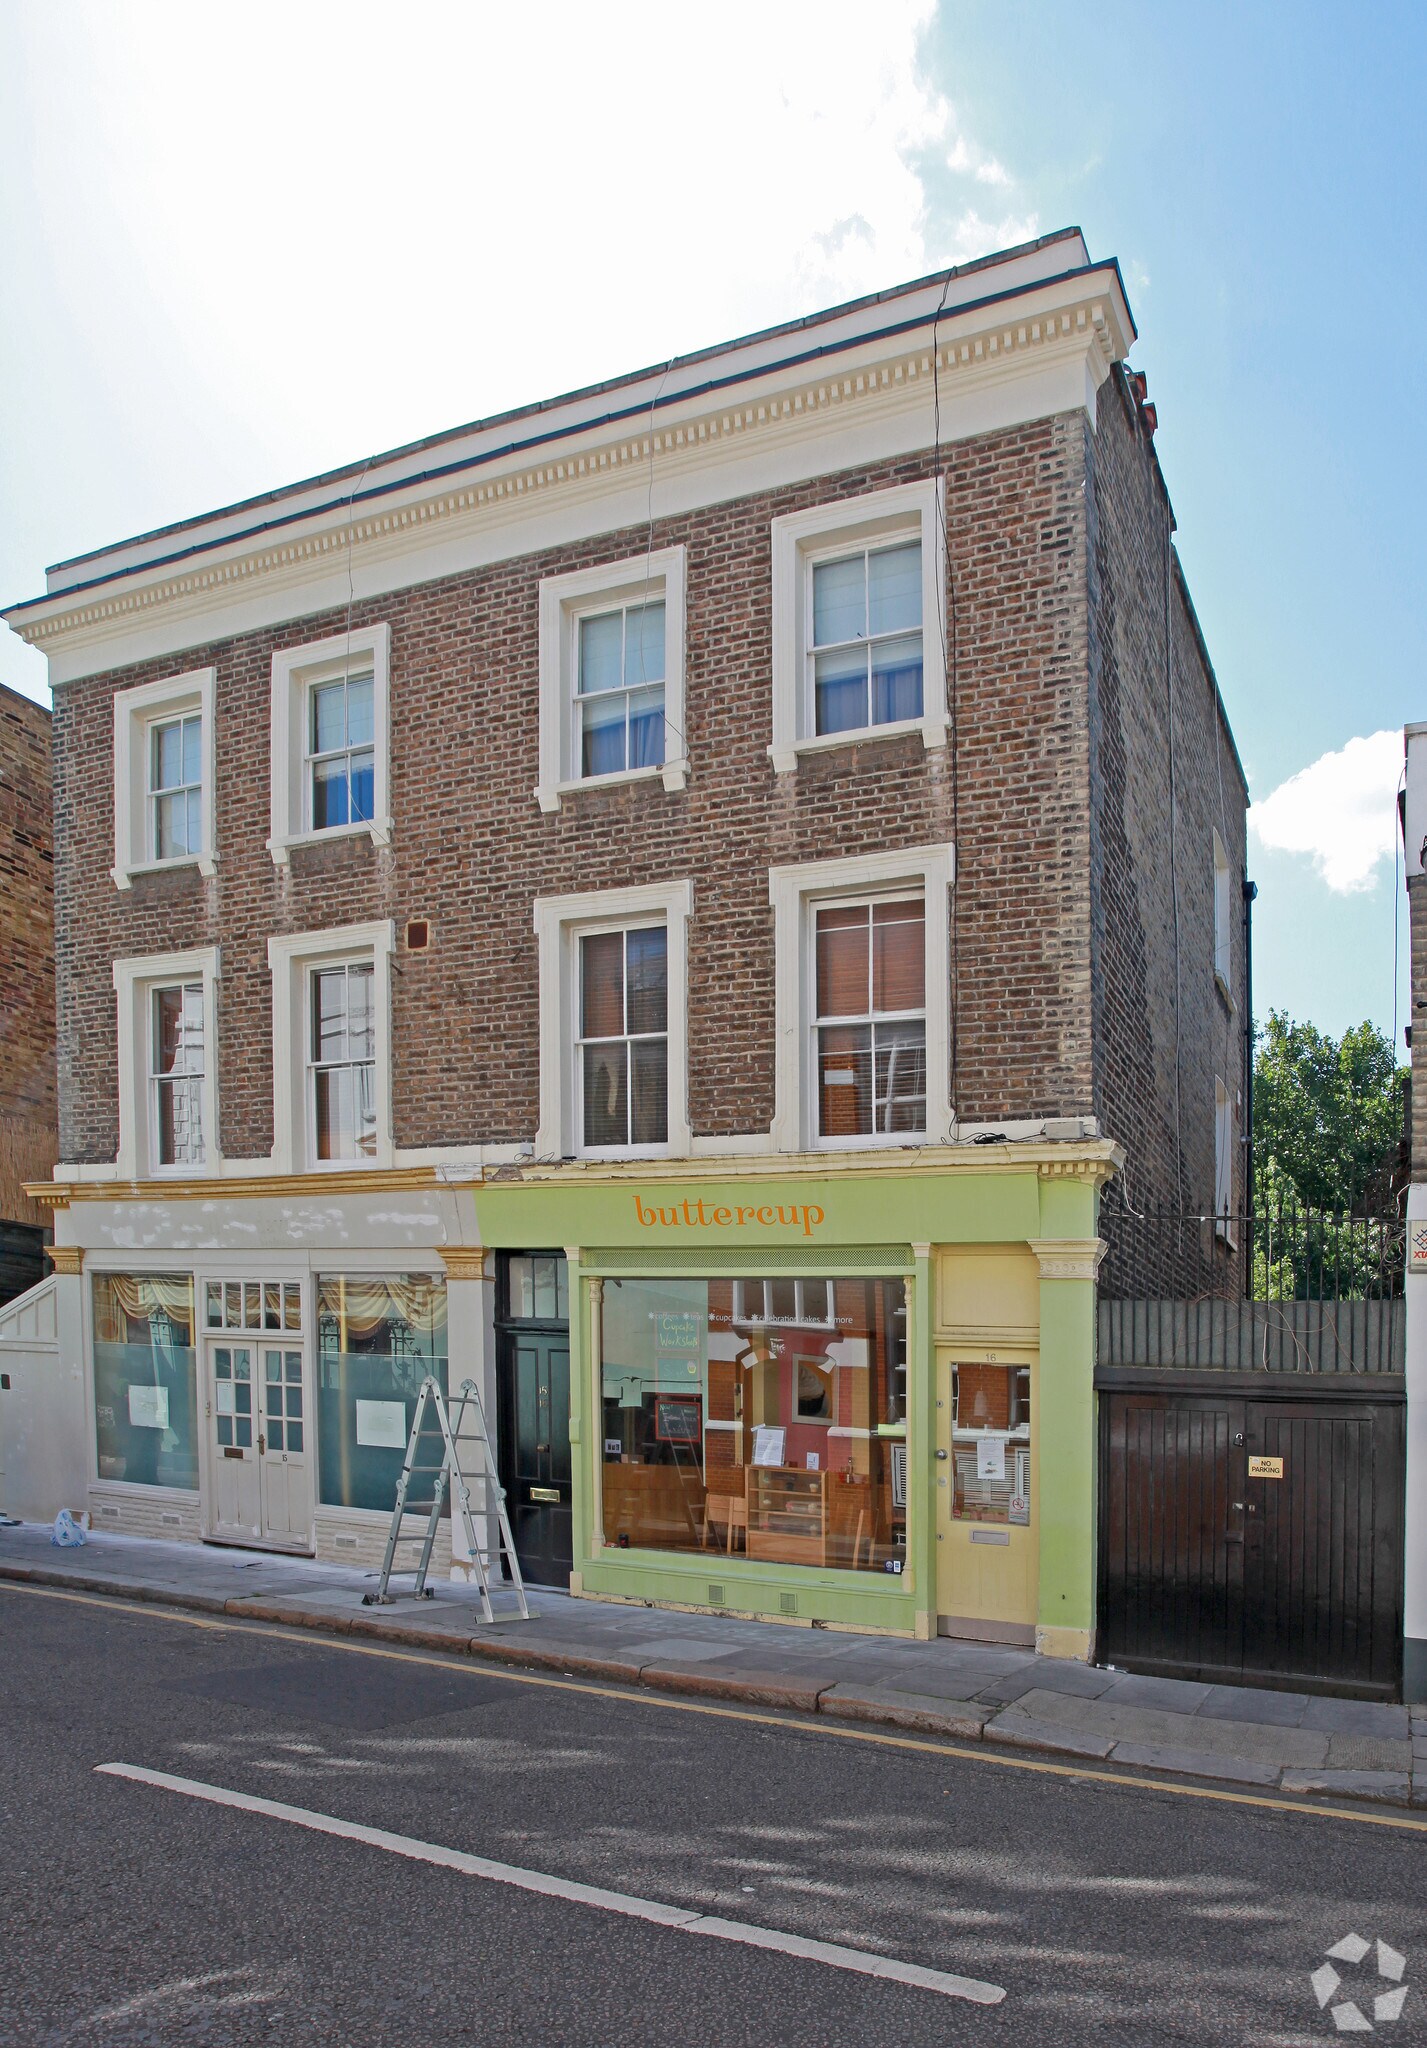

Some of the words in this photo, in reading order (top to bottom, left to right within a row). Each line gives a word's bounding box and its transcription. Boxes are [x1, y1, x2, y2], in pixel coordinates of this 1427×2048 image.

[632, 1195, 825, 1236] buttercup
[715, 1314, 747, 1323] cupcakes
[800, 1315, 821, 1324] cakes
[834, 1316, 853, 1324] more
[985, 1353, 997, 1362] 16
[539, 1385, 549, 1395] 15
[281, 1454, 288, 1463] 15
[1251, 1466, 1280, 1474] PARKING
